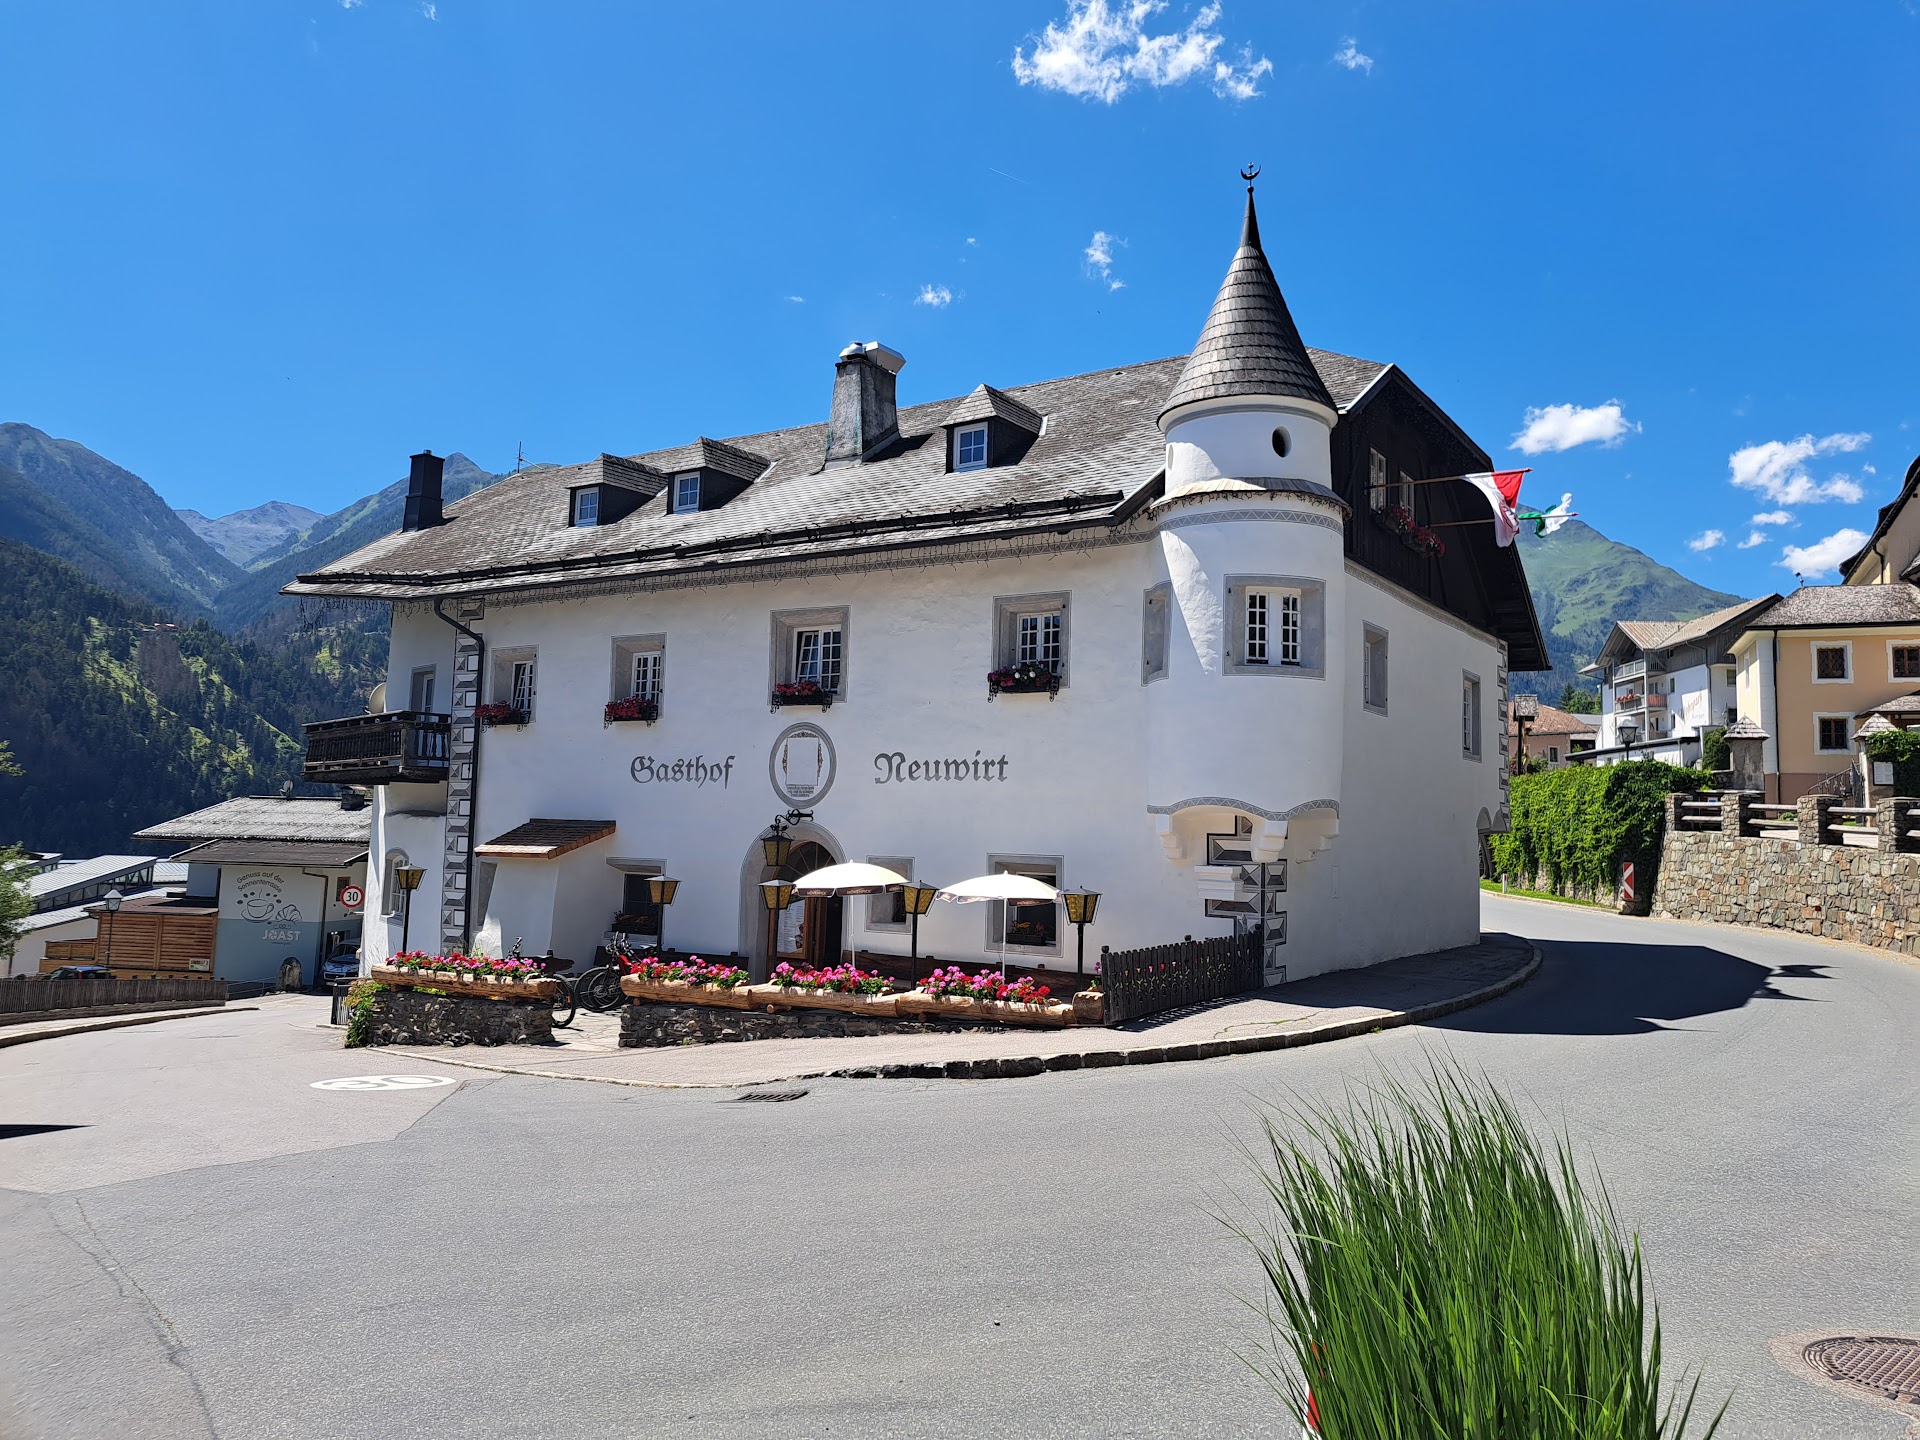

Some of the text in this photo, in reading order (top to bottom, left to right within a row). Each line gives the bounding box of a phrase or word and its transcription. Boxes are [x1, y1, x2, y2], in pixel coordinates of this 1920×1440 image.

[630, 749, 1009, 790] Gasthof Neuwirt
[236, 871, 261, 884] Genuss
[273, 874, 285, 884] der
[237, 879, 282, 893] Sonnenterrasse
[345, 891, 359, 902] 30
[321, 1075, 444, 1090] 30
